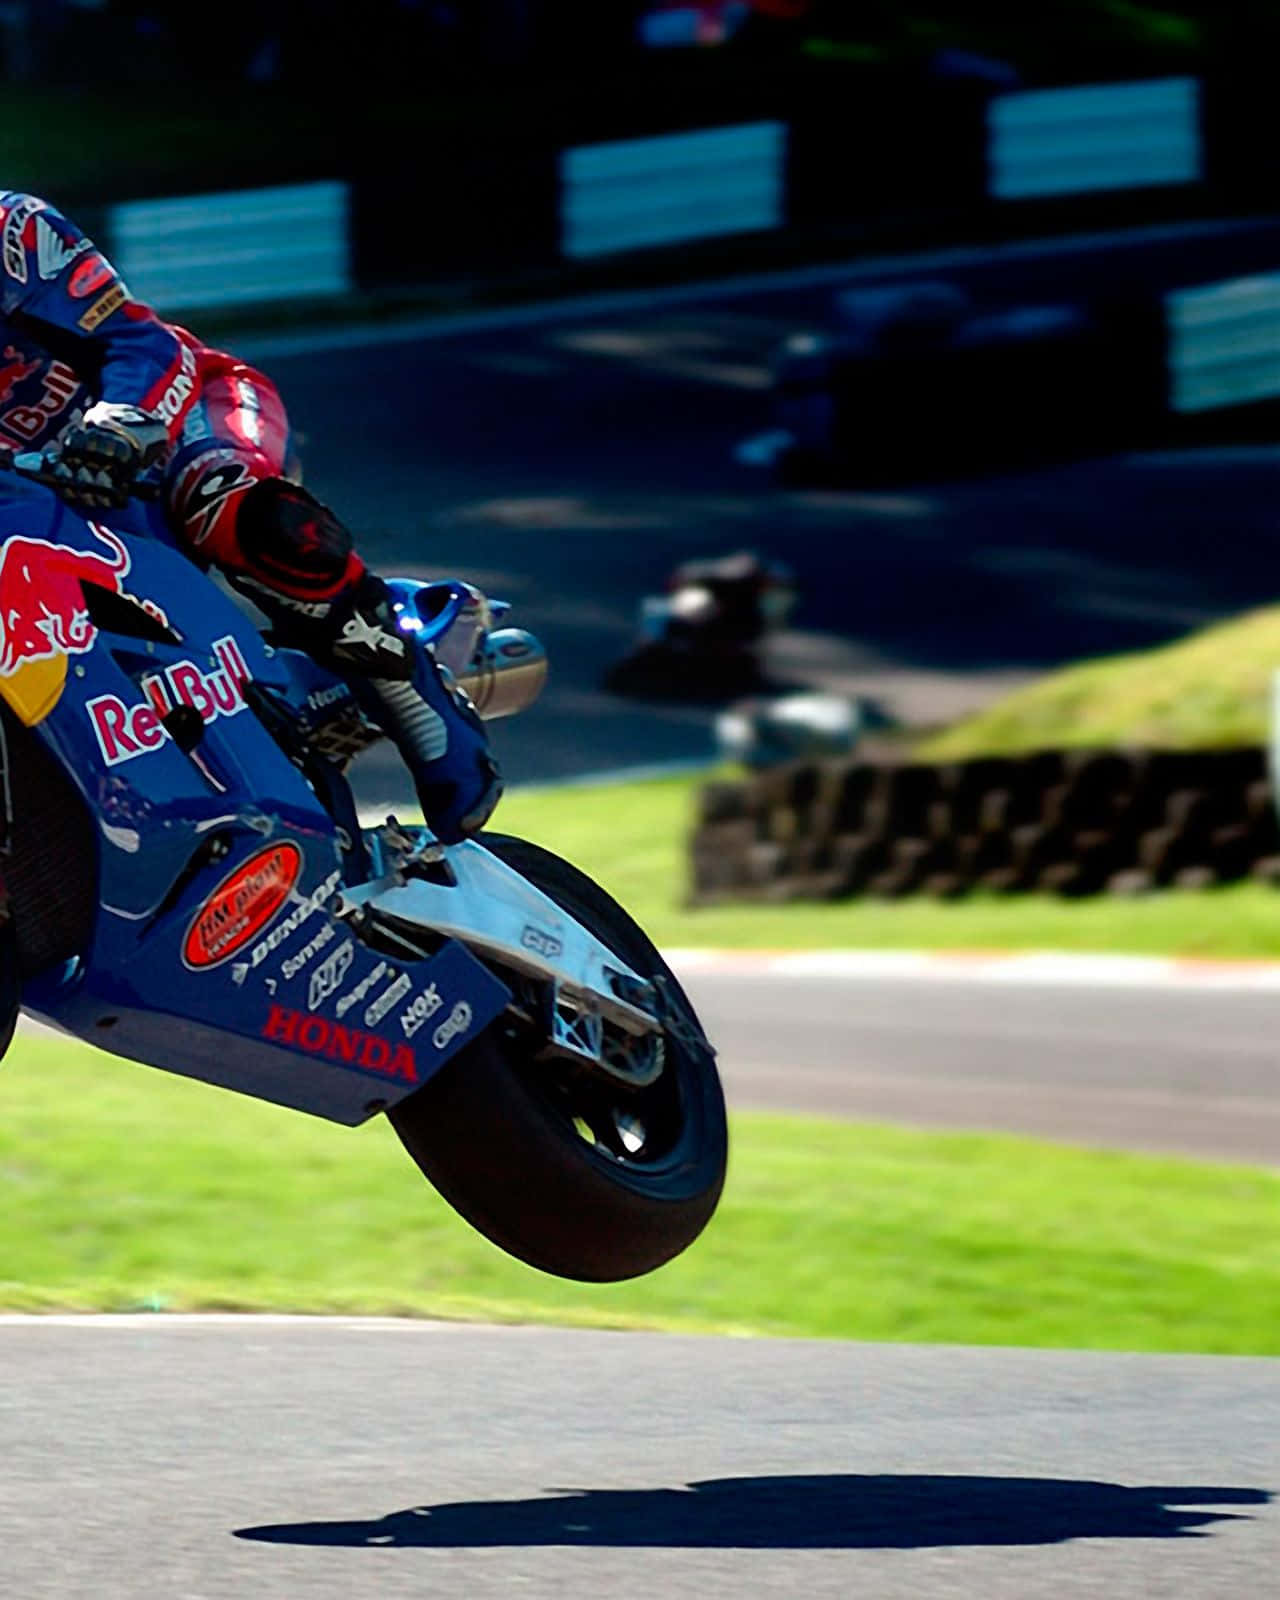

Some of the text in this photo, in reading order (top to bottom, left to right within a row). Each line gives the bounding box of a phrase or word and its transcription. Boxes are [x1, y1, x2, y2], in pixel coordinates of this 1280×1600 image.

[0, 360, 81, 440] Bull
[165, 635, 254, 726] Bull
[251, 869, 341, 968] DUNLOP
[262, 1003, 419, 1083] HONDA
